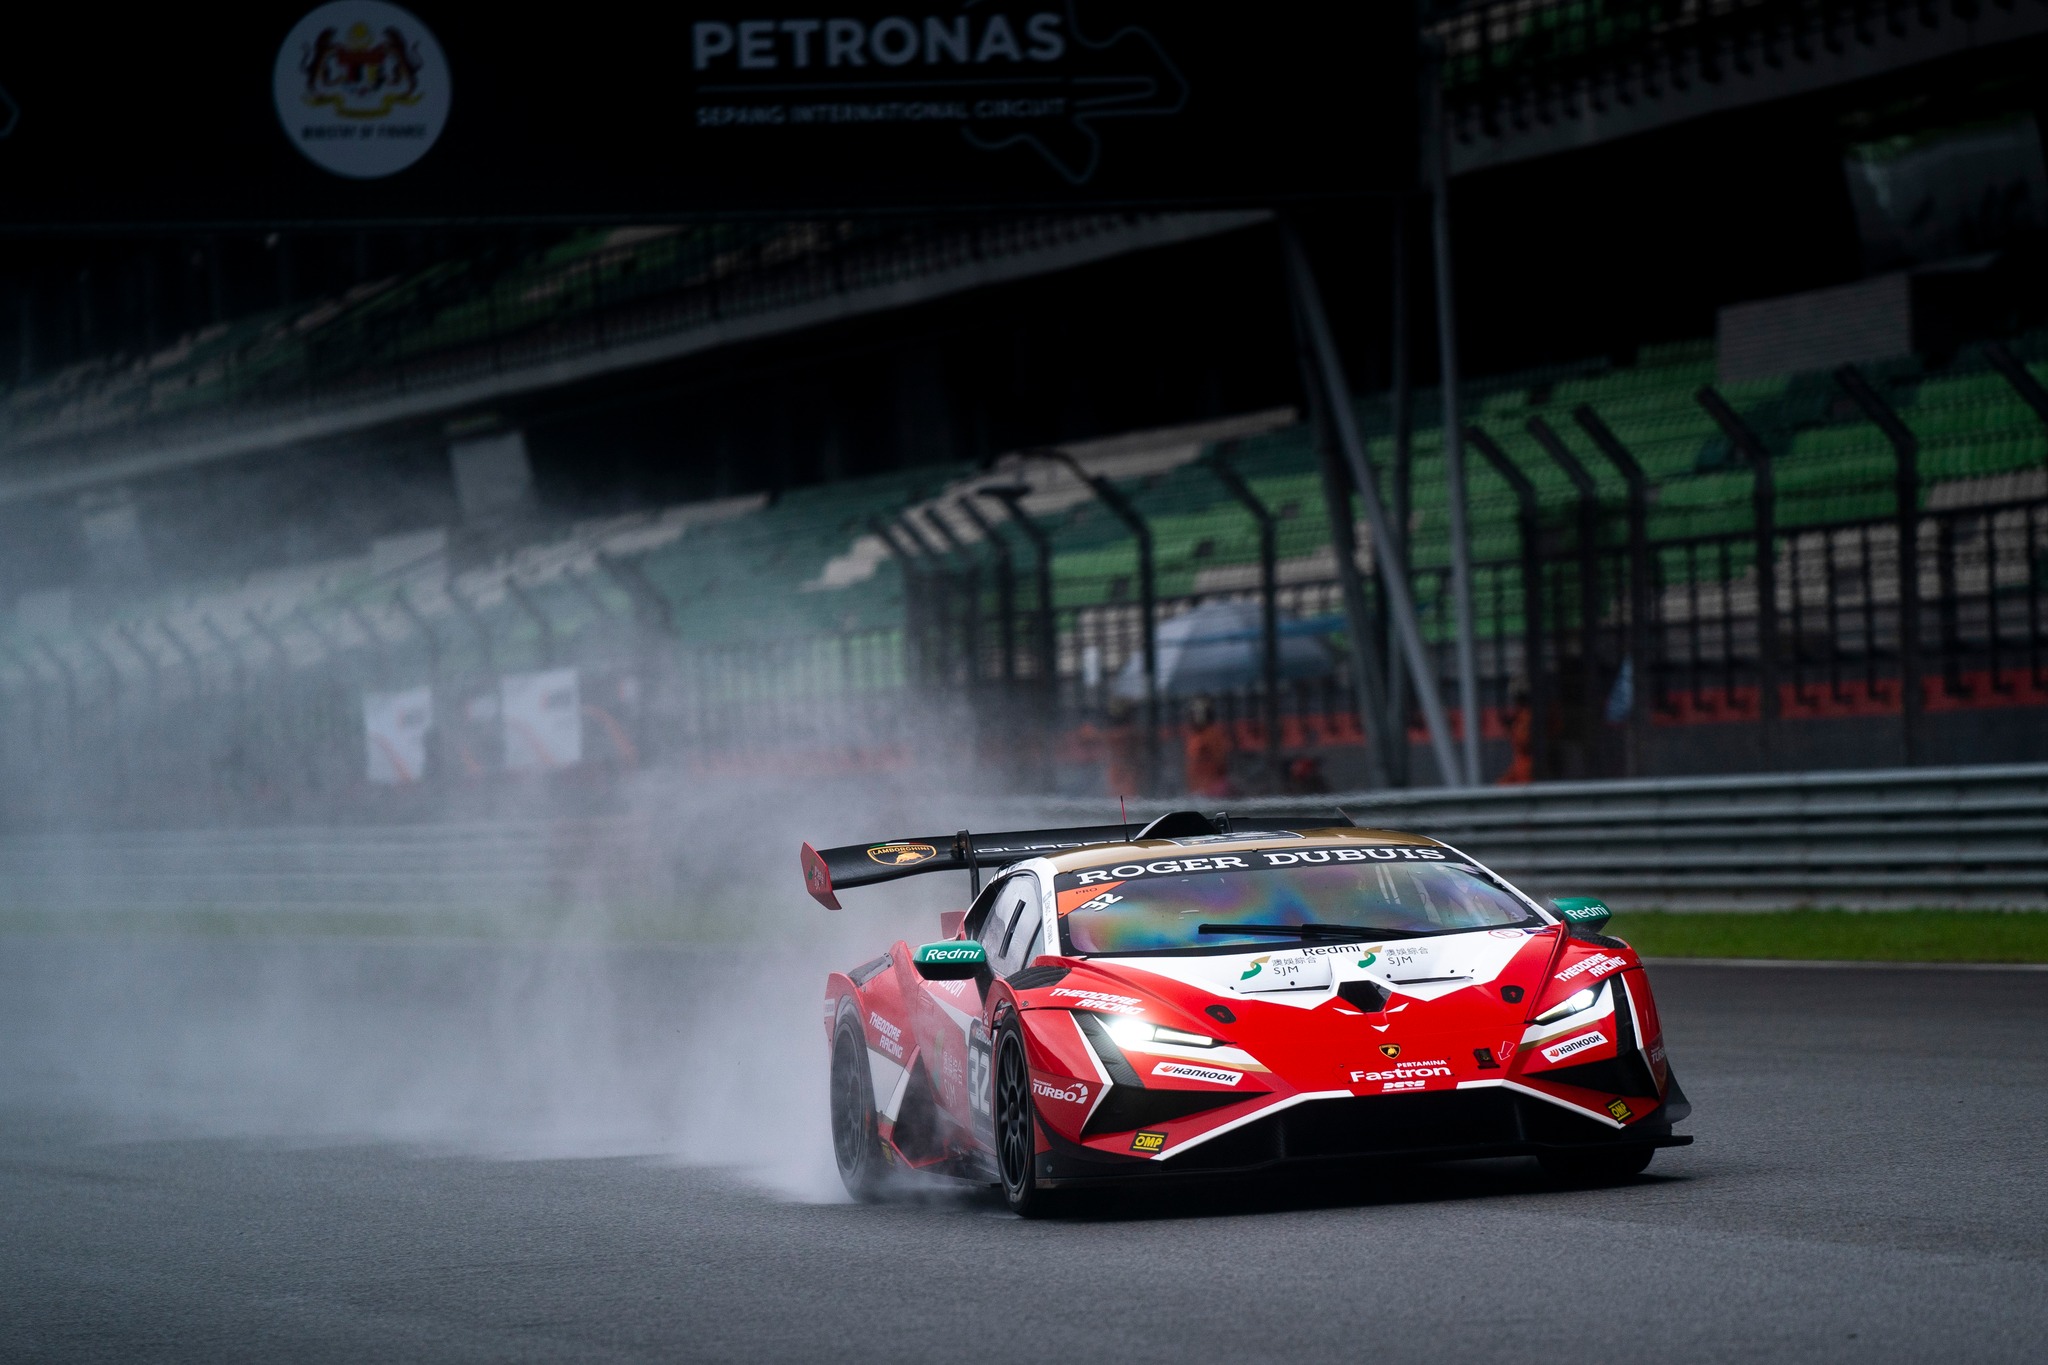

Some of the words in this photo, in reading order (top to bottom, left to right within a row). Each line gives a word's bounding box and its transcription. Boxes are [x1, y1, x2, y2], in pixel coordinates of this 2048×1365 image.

[692, 11, 1067, 71] PETRONAS
[696, 105, 786, 128] SEPANG
[789, 100, 971, 125] INTERNATIONAL
[973, 97, 1068, 121] CIRCUIT
[872, 845, 932, 855] LAMBORGHINI
[1079, 855, 1249, 885] ROGER
[1264, 848, 1447, 866] DUBUIS
[1075, 887, 1098, 895] PRO
[1080, 893, 1124, 912] 32
[1564, 904, 1609, 920] Redmi
[925, 948, 983, 961] Redmi
[1302, 944, 1361, 957] Redmi
[1387, 956, 1413, 967] SJM
[1554, 952, 1609, 982] THEODORE
[1588, 956, 1627, 978] RACING
[1273, 965, 1300, 977] SJM
[1049, 988, 1142, 1005] THEODORE
[1075, 998, 1145, 1015] RACING
[868, 1011, 902, 1042] THEODORE
[879, 1034, 904, 1059] RACING
[1396, 1059, 1447, 1068] PERTAMINA
[968, 1044, 991, 1117] 32
[1350, 1066, 1452, 1083] Fastron
[1033, 1083, 1077, 1102] TURBO
[1611, 1102, 1628, 1118] OMP
[1135, 1135, 1163, 1148] OMP
